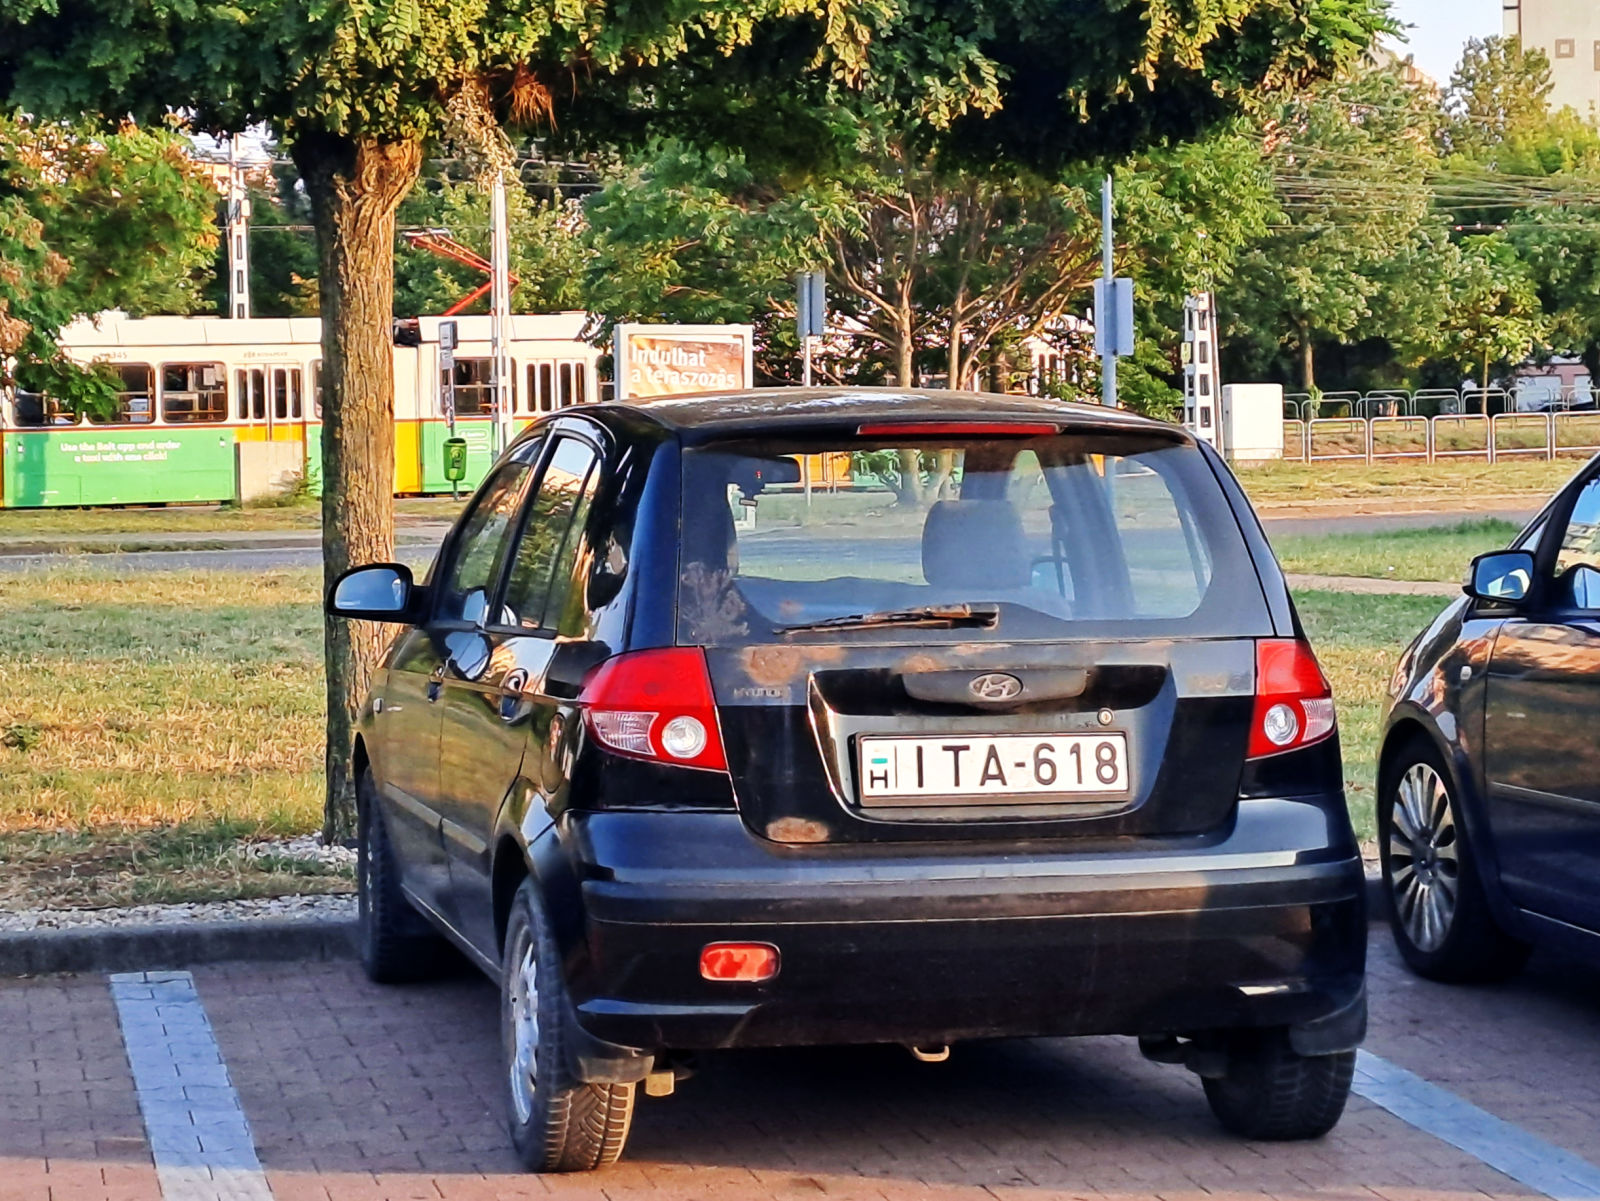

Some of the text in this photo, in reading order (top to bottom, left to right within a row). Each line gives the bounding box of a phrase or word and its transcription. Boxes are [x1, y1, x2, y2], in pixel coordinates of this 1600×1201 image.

[632, 344, 706, 367] Indulhat
[631, 366, 736, 388] a teraszozás
[60, 441, 180, 452] Use the Bolt app and order
[82, 452, 101, 462] taxi
[102, 452, 124, 462] with
[915, 741, 1119, 788] ITA-618
[869, 769, 889, 789] H
